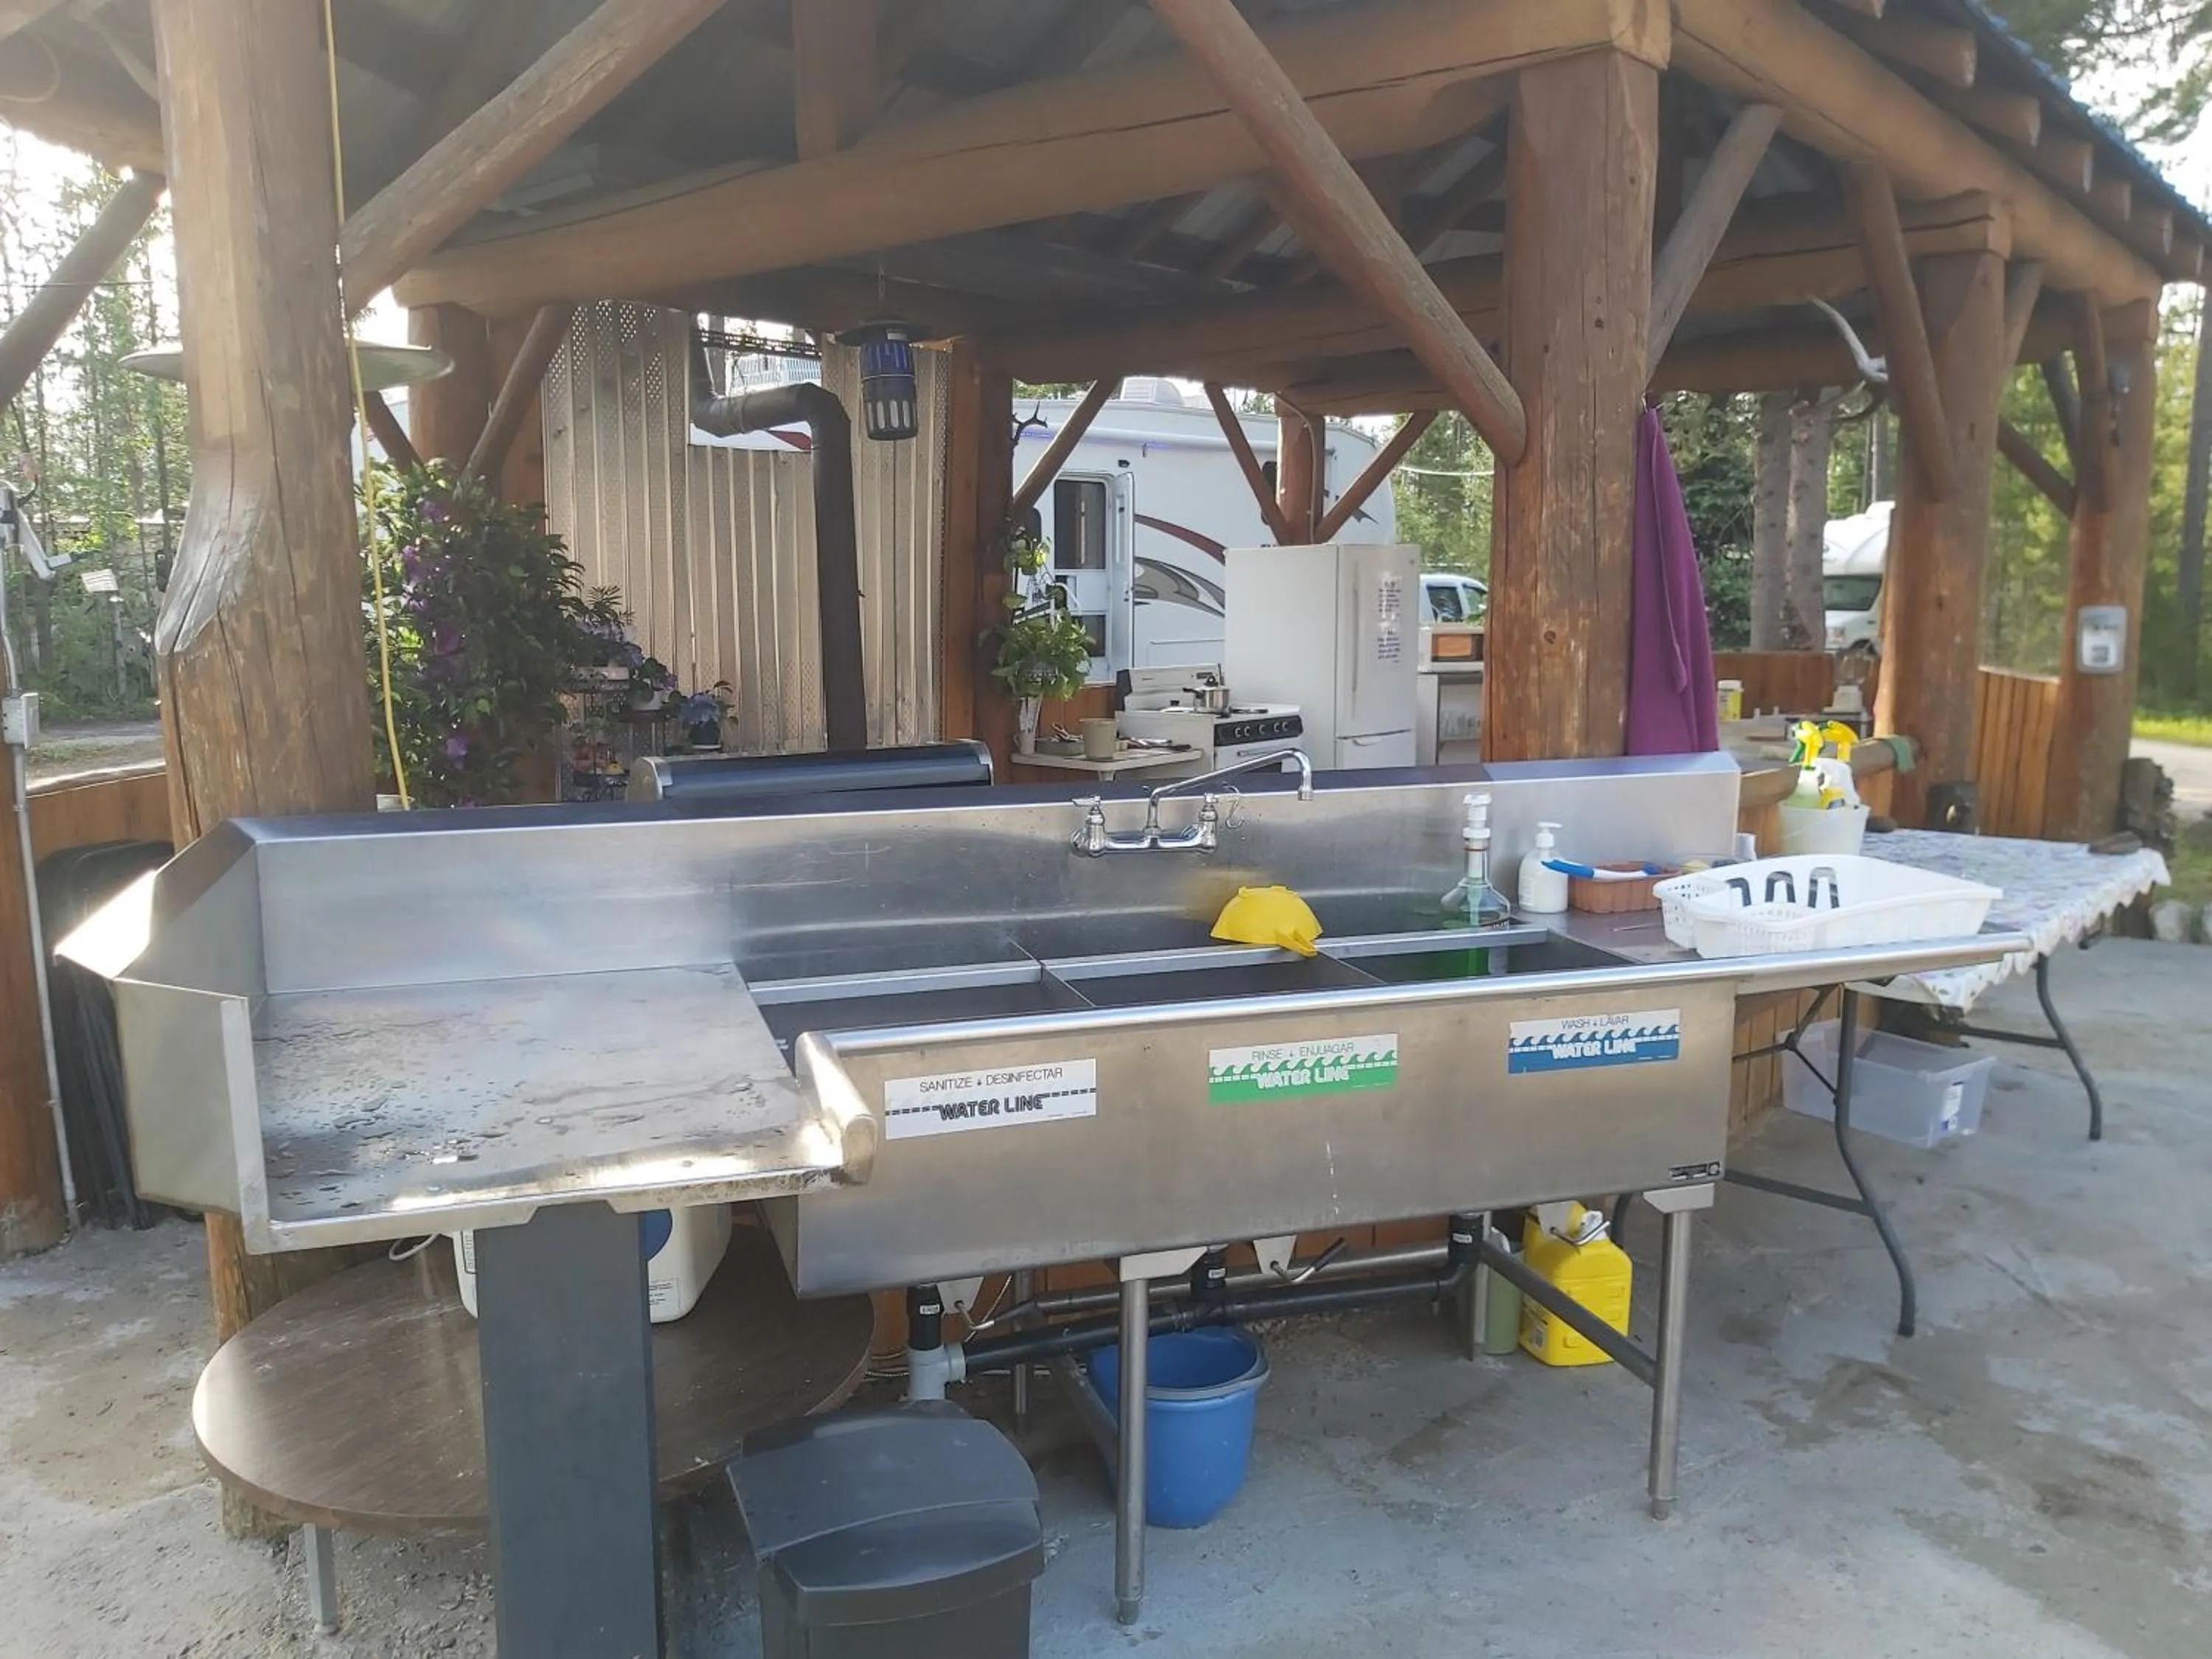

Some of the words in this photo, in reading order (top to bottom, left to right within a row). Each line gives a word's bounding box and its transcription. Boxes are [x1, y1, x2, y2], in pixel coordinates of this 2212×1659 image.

[1562, 1019, 1590, 1029] WASH
[1600, 1015, 1629, 1026] LAVAR
[1252, 1049, 1284, 1061] RINSE
[1299, 1042, 1354, 1057] ENJUAGAR
[1552, 1040, 1601, 1060] WATER
[1604, 1037, 1636, 1054] LINE
[919, 1077, 972, 1092] SANITIZE
[986, 1068, 1062, 1086] DESINFECTAR
[1256, 1069, 1311, 1088] WATER
[1315, 1066, 1349, 1082] LINE
[938, 1099, 1000, 1120] WATER
[1004, 1093, 1043, 1113] LINE
